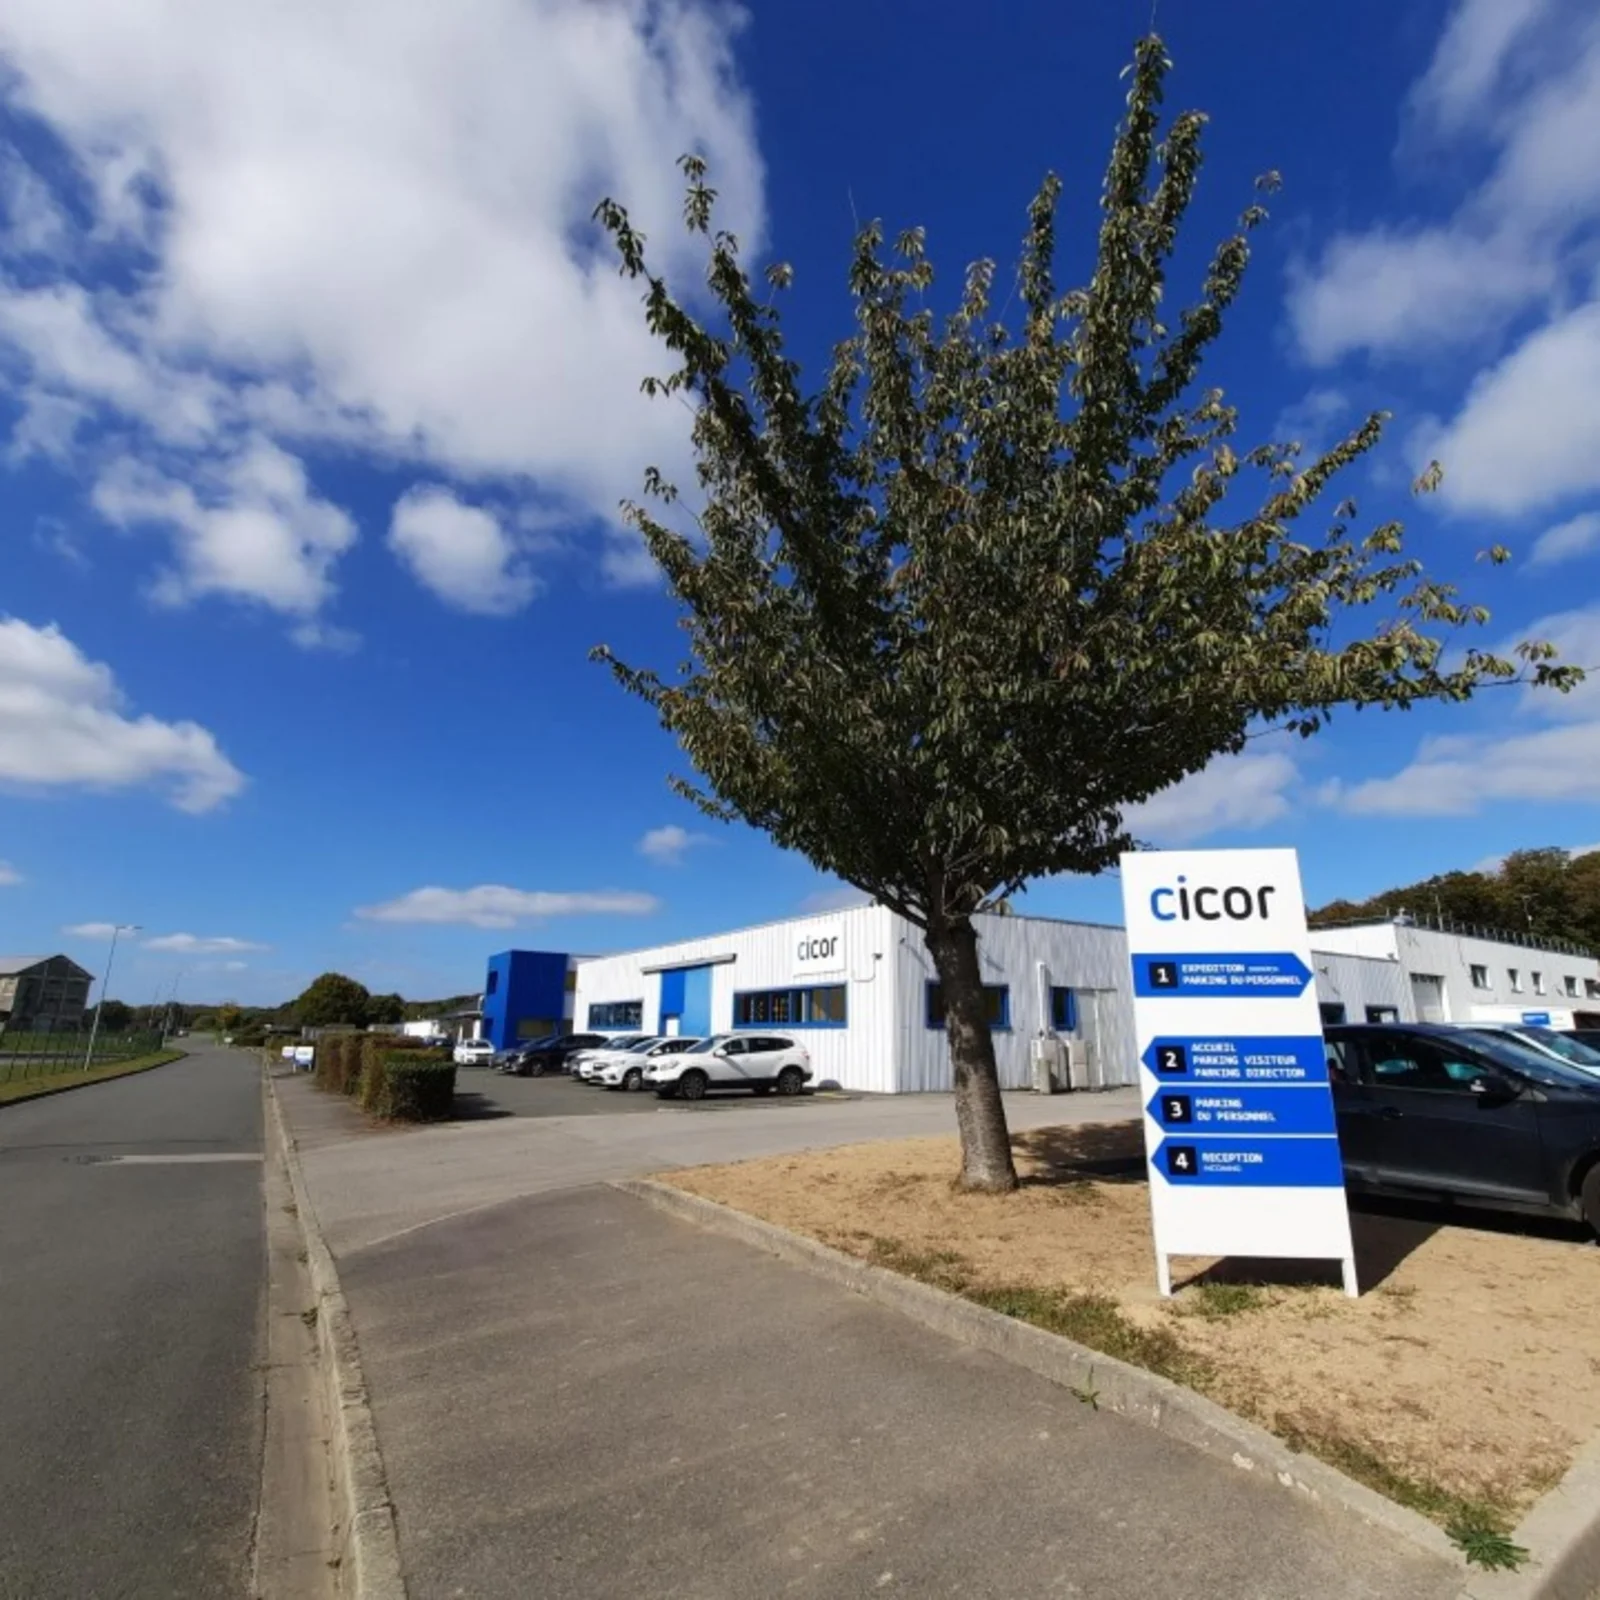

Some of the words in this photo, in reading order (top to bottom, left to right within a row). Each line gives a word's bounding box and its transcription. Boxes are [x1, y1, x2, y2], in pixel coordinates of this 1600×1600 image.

[1150, 874, 1276, 921] cicor
[797, 934, 839, 961] cicor
[1157, 967, 1170, 984] 1
[1182, 975, 1228, 986] PARKING
[1191, 1042, 1237, 1053] ACCUEIL
[1165, 1051, 1178, 1068] 2
[1192, 1055, 1239, 1066] PARKING
[1243, 1055, 1298, 1066] VISITEUR
[1194, 1068, 1241, 1078] PARKING
[1245, 1067, 1306, 1078] DIRECTION
[1195, 1098, 1243, 1108] PARKING
[1170, 1101, 1183, 1118] 3
[1196, 1111, 1212, 1121] DU
[1175, 1152, 1189, 1170] 4
[1201, 1152, 1264, 1164] RECEPTION
